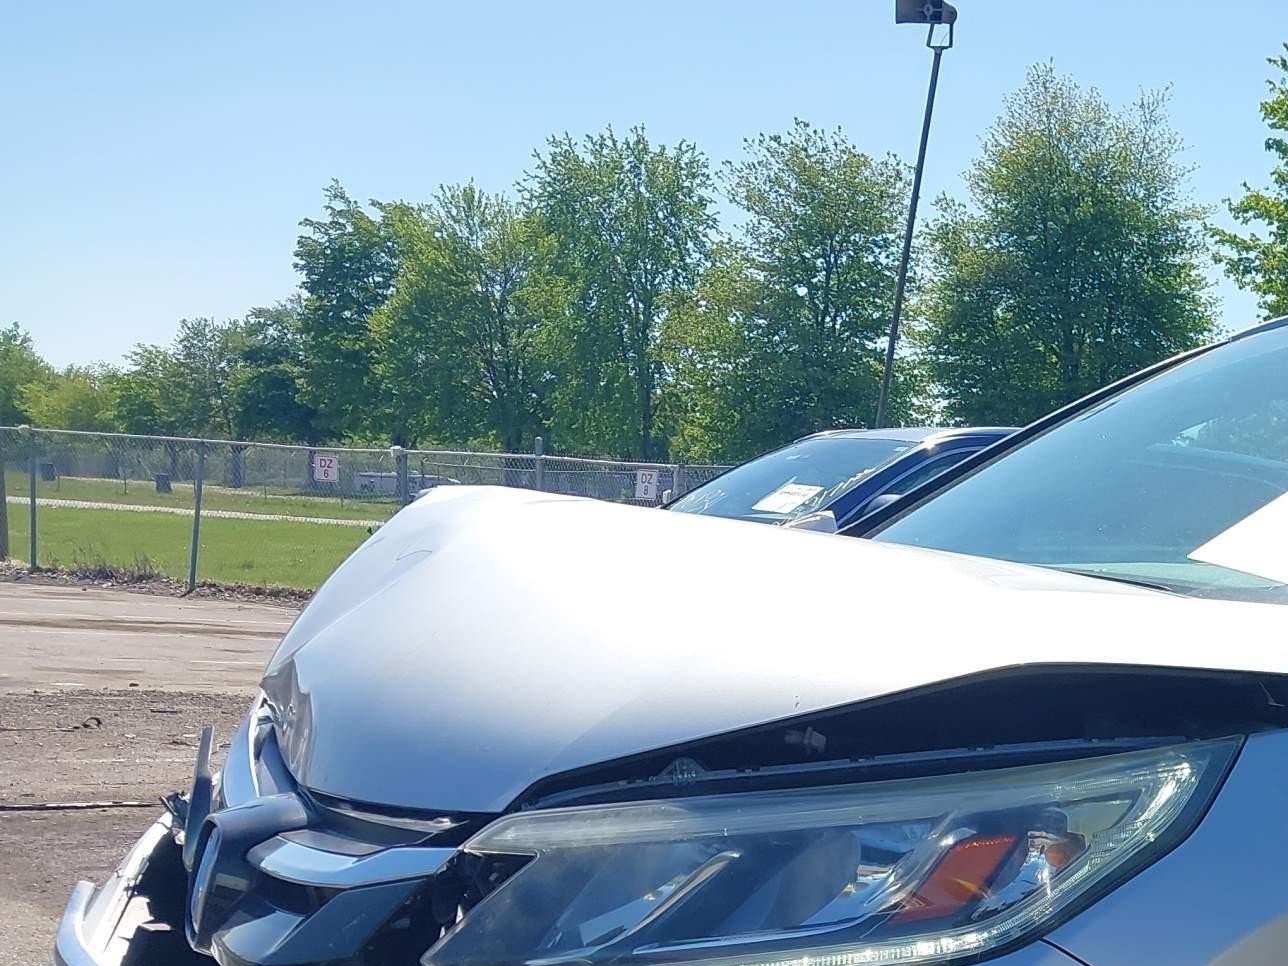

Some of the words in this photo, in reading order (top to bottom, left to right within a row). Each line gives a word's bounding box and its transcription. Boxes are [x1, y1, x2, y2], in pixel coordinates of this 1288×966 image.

[320, 458, 333, 468] DZ
[323, 469, 329, 479] 6
[643, 484, 649, 495] 8
